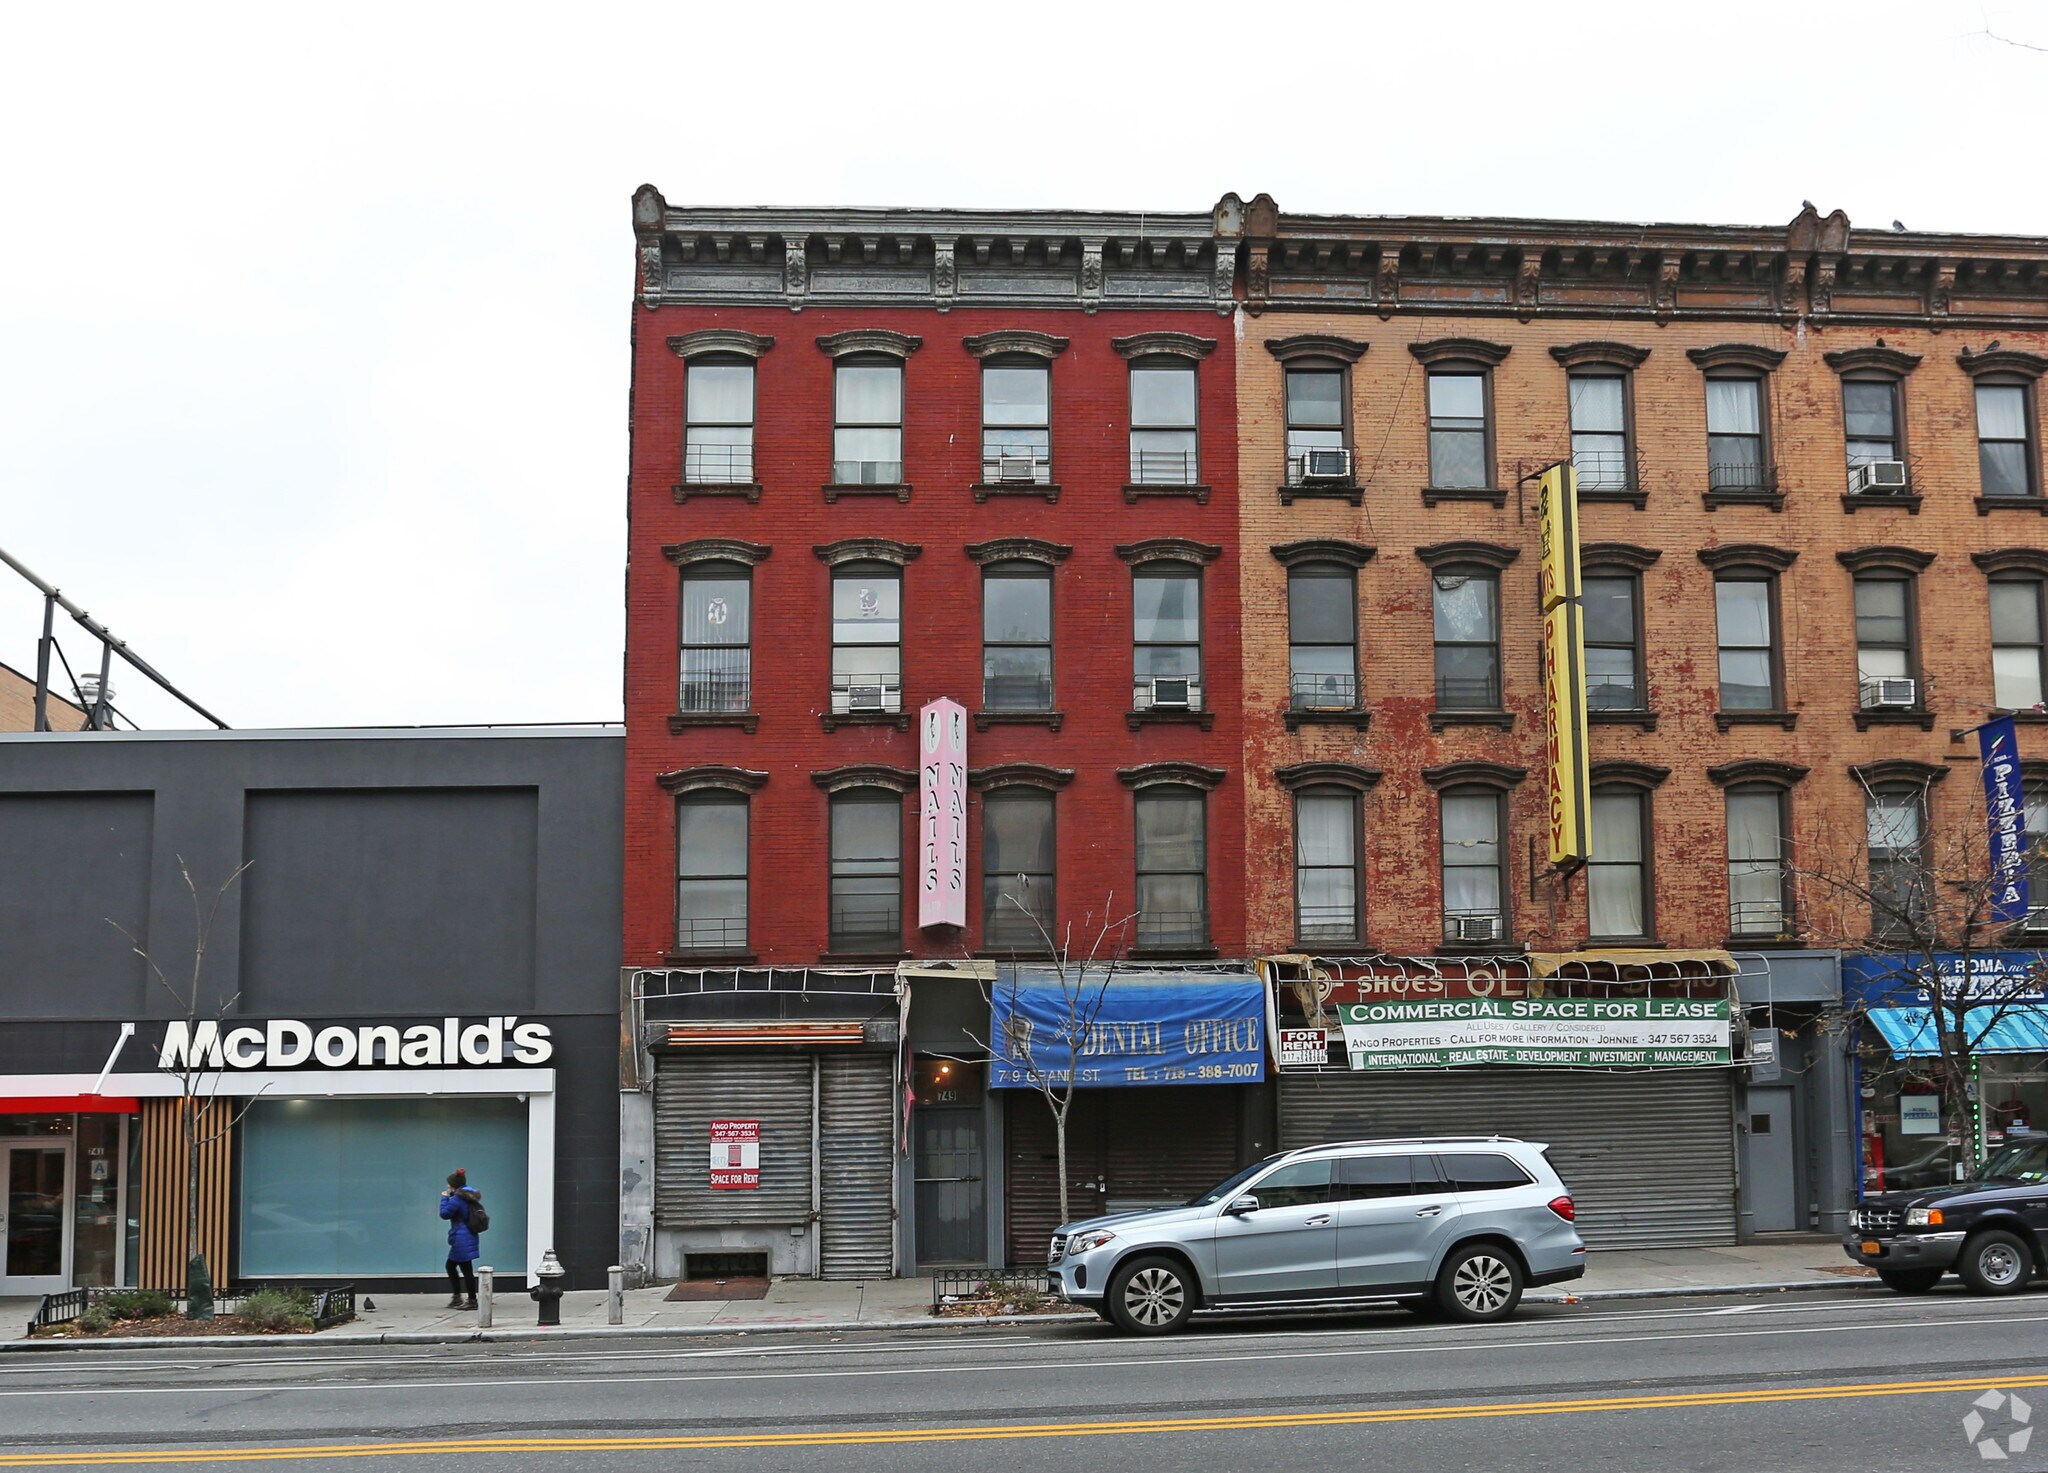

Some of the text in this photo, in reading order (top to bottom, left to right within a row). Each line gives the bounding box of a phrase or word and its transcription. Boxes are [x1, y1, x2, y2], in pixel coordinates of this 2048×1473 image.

[1545, 619, 1563, 853] PHARMACY
[925, 762, 940, 893] NAILS
[949, 762, 963, 892] NAILS
[1994, 763, 2022, 903] PIZZERIA
[1955, 959, 2006, 973] ROMA
[1357, 974, 1444, 993] SHOES
[1349, 1000, 1718, 1021] COMMERCIAL SPACE FOR LEASE
[1466, 1023, 1482, 1031] ALL
[1483, 1022, 1504, 1031] USES
[1512, 1023, 1546, 1032] GALLERY
[1556, 1023, 1606, 1032] CONSIDERED
[157, 1016, 553, 1068] McDonald's
[1082, 1020, 1166, 1056] DENTAL
[1184, 1017, 1260, 1055] OFFICE
[1287, 1032, 1318, 1041] FOR
[1352, 1034, 1718, 1048] ANGO PROPERTIES CALL FOR MORE INFORMATION JOHNNIE 347 567 3534
[1283, 1041, 1323, 1050] RENT
[1368, 1049, 1718, 1066] INTERNATIONAL REAL ESTATE DEVELOPMENT INVESTMENT MANAGEMENT
[998, 1070, 1020, 1082] 749
[938, 1091, 957, 1101] 749
[1903, 1112, 1939, 1120] PIZZERIA
[711, 1122, 759, 1130] ANGO PROPERTY
[94, 1163, 105, 1174] A
[710, 1173, 759, 1184] SPACE FOR RENT
